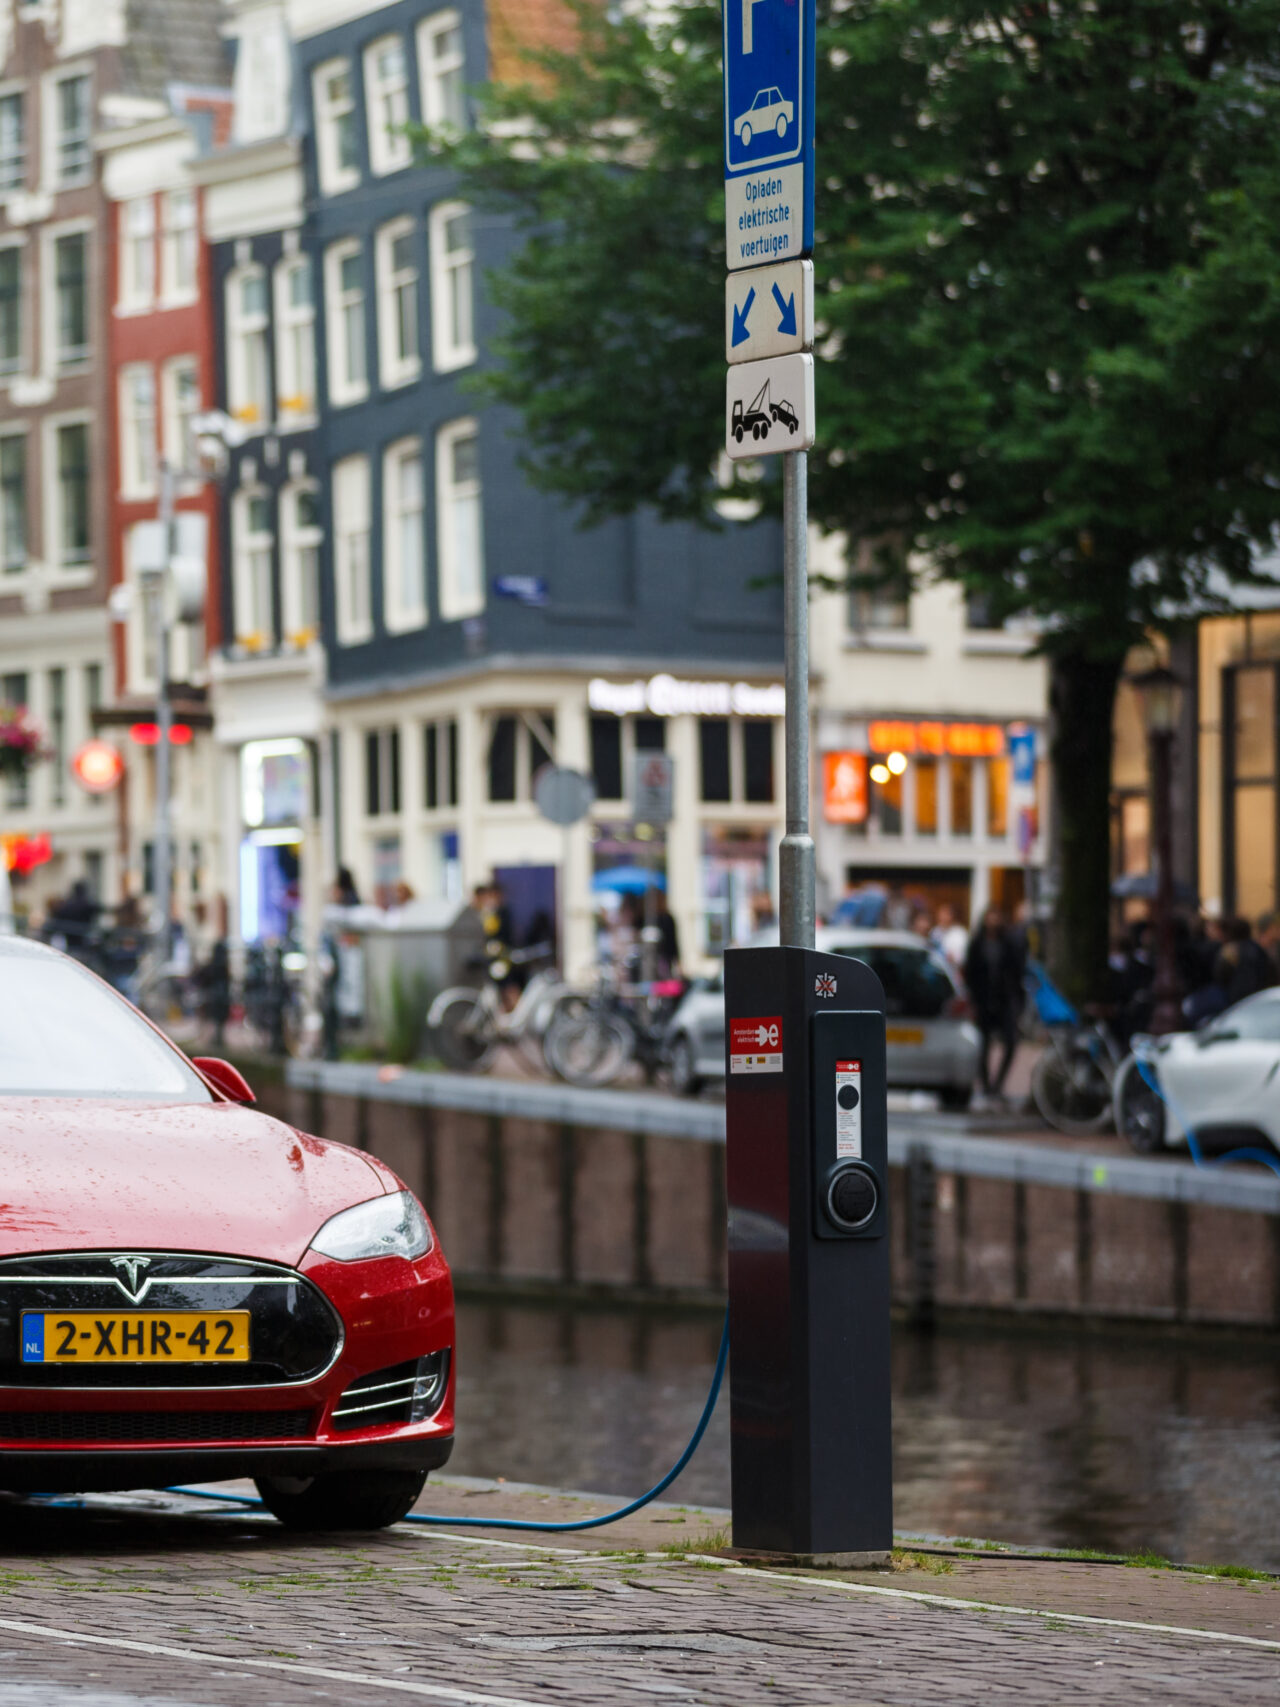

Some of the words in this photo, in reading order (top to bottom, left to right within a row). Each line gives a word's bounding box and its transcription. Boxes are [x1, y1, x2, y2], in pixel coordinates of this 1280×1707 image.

[745, 177, 782, 203] Opladen
[738, 203, 790, 230] elektrische
[740, 234, 789, 258] voertuigen
[25, 1342, 41, 1354] NL
[55, 1320, 235, 1357] 2-XHR-42
